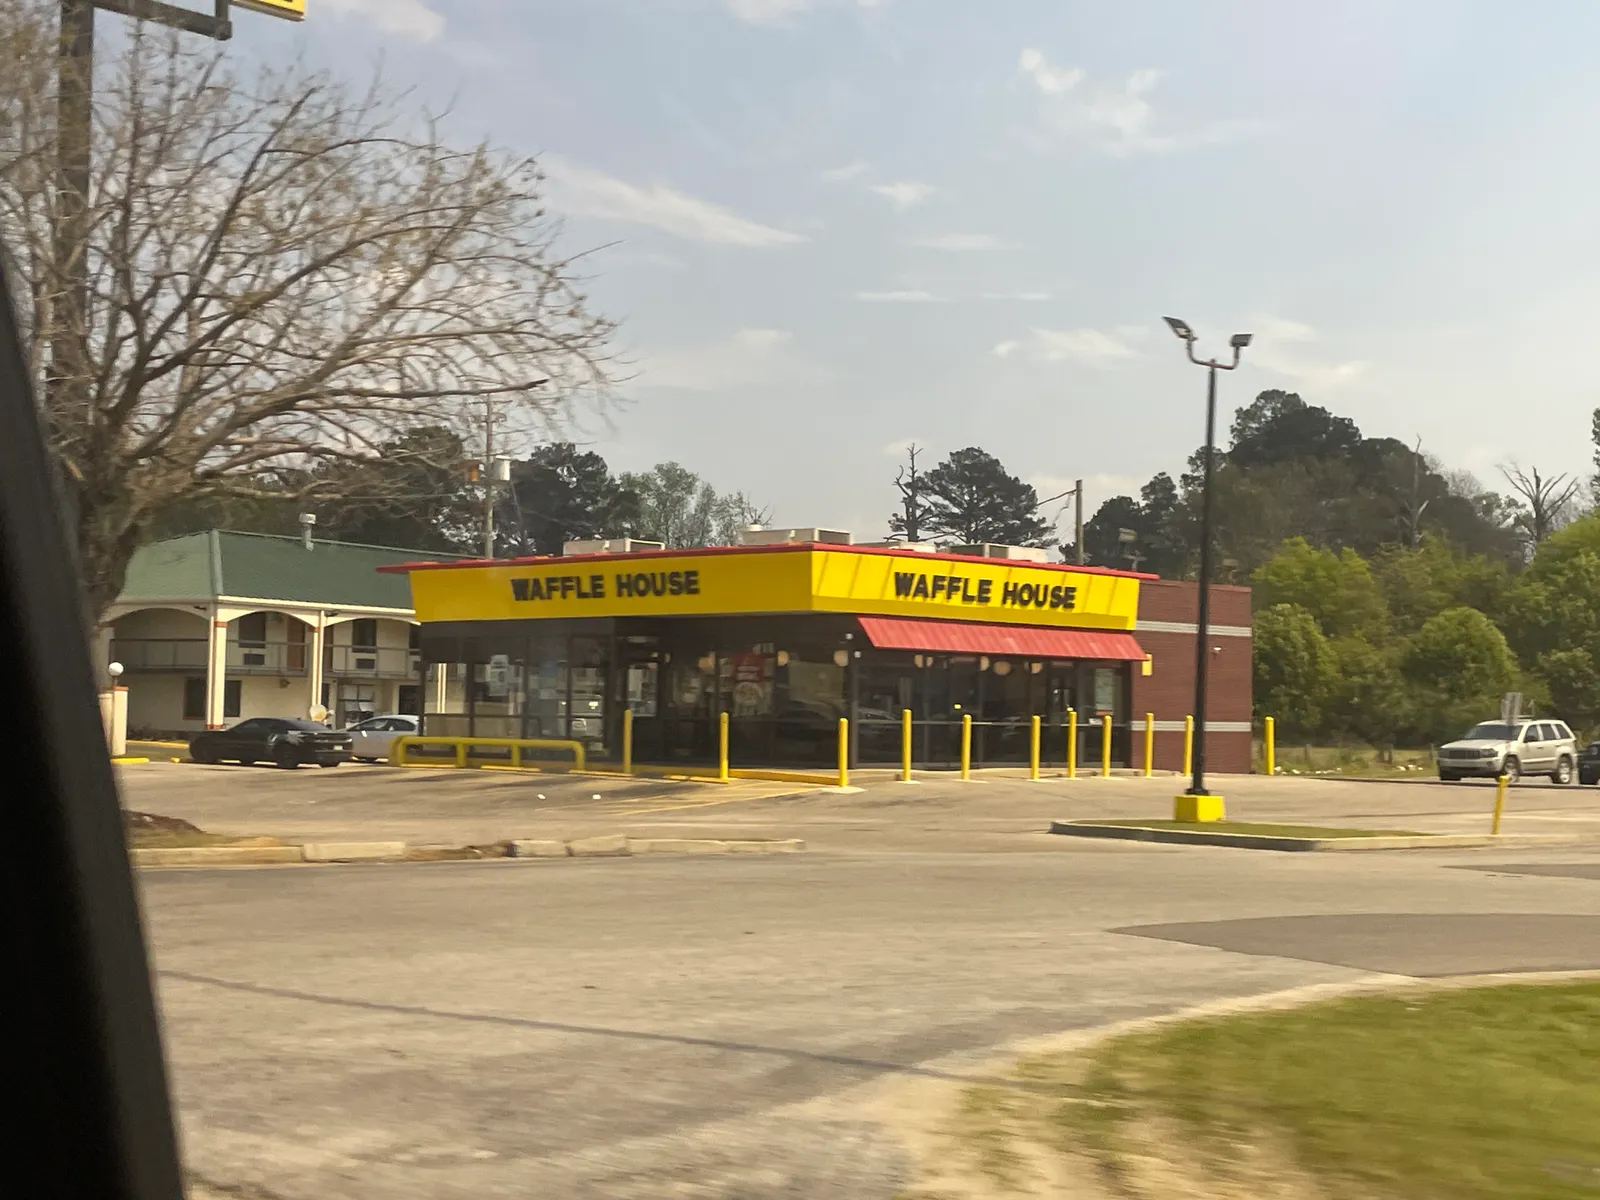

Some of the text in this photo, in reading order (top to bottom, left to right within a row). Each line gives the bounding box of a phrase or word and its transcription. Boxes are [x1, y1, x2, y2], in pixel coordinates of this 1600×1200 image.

[511, 570, 700, 601] WAFFLE HOUSE
[894, 572, 1077, 608] WAFFLE HOUSE
